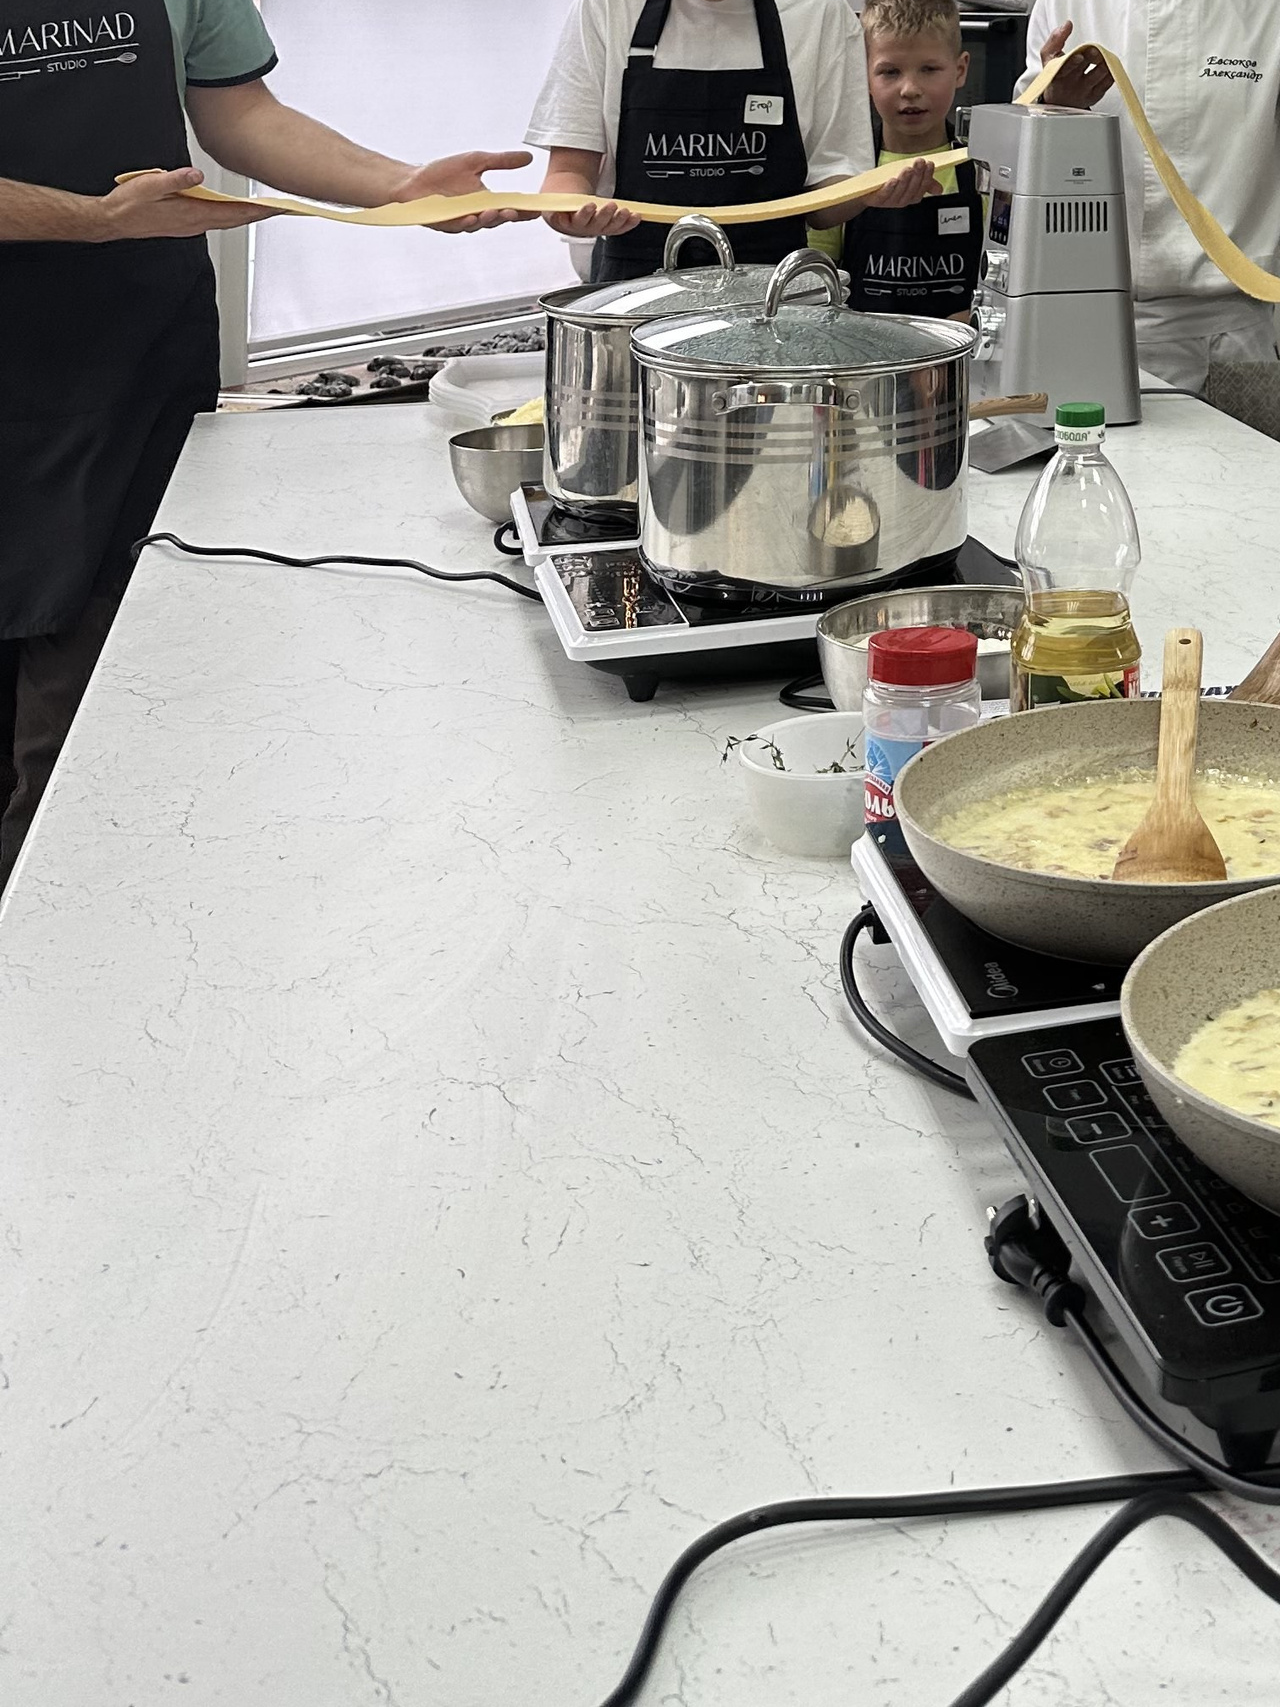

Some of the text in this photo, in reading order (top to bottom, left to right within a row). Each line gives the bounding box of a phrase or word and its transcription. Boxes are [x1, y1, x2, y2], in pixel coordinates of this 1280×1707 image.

[46, 58, 87, 73] STUDIO
[1206, 55, 1257, 69] Евсюков
[1199, 67, 1263, 83] Александр
[644, 130, 767, 157] MARINAD
[689, 167, 726, 177] STUDIO
[864, 253, 965, 278] MARINAD
[896, 287, 929, 296] STUDIO
